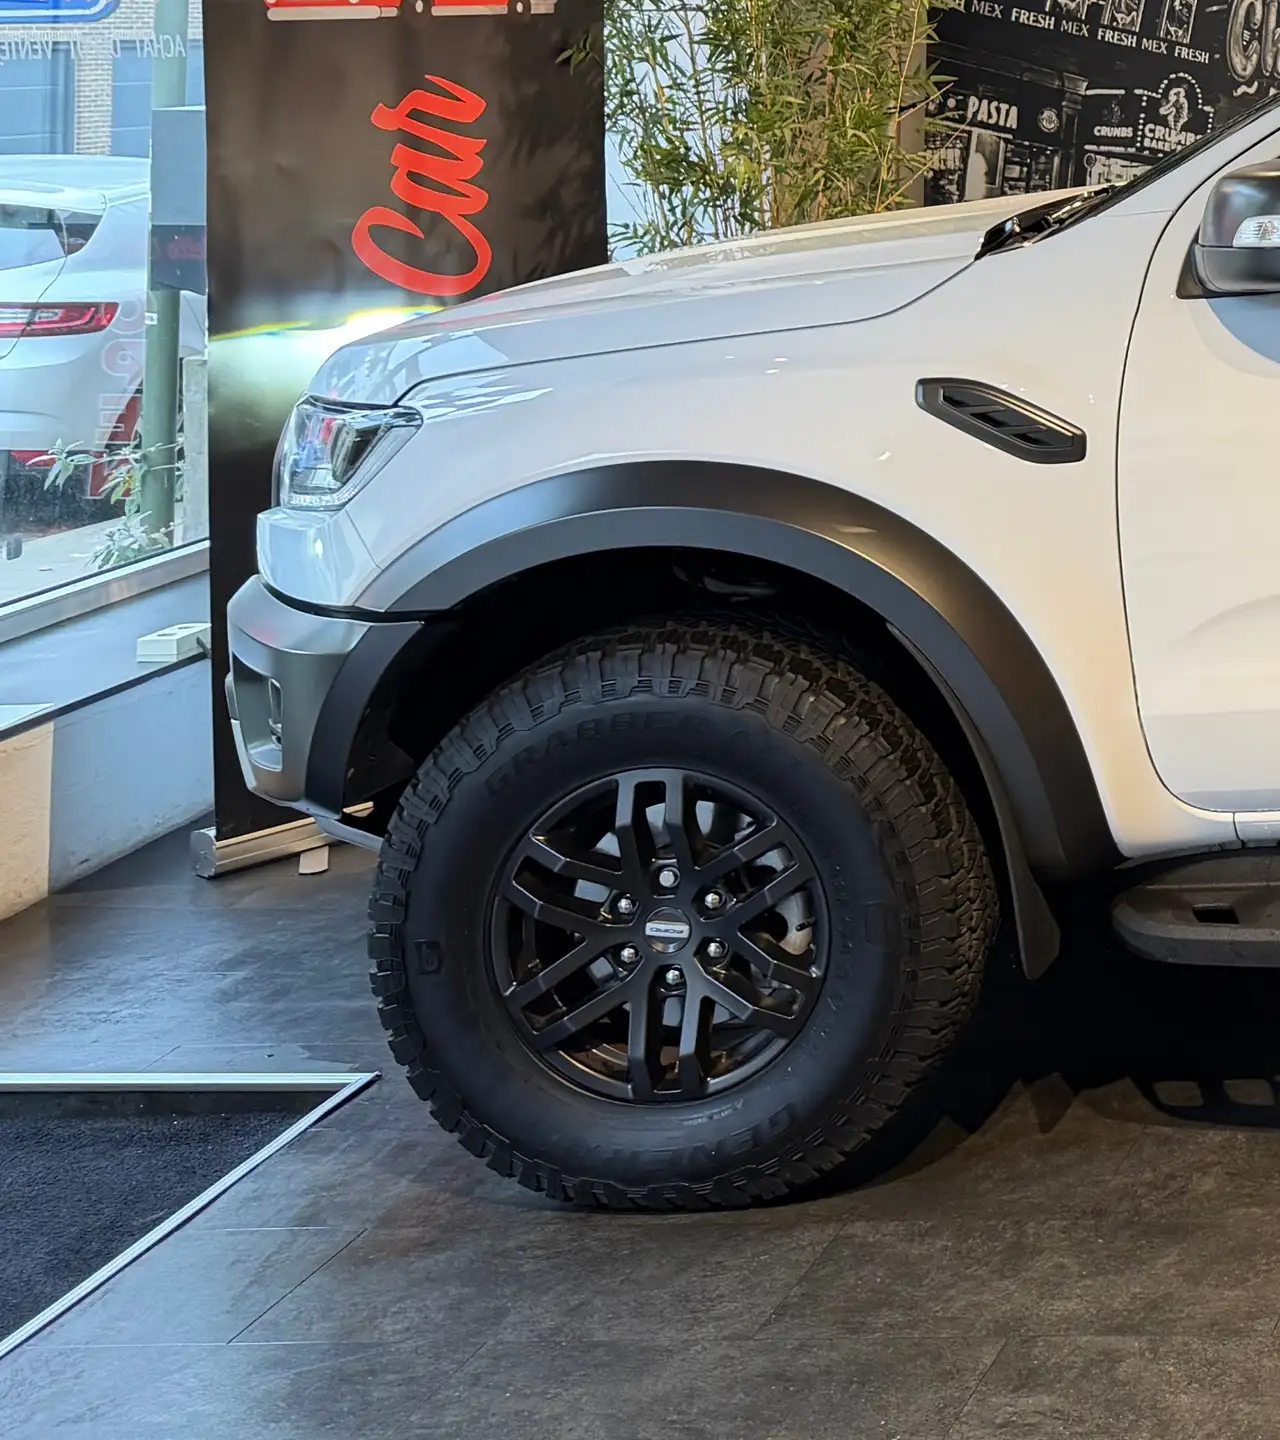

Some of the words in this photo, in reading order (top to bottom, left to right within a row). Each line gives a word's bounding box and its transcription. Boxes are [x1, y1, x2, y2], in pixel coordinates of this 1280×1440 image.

[971, 0, 1004, 19] MEX
[1010, 7, 1055, 30] FRESH
[1060, 19, 1090, 38] MEX
[1097, 27, 1137, 48] FRESH
[1141, 37, 1168, 55] MEX
[1174, 45, 1210, 64] FRESH
[967, 95, 1019, 130] PASTA
[351, 74, 493, 296] Car
